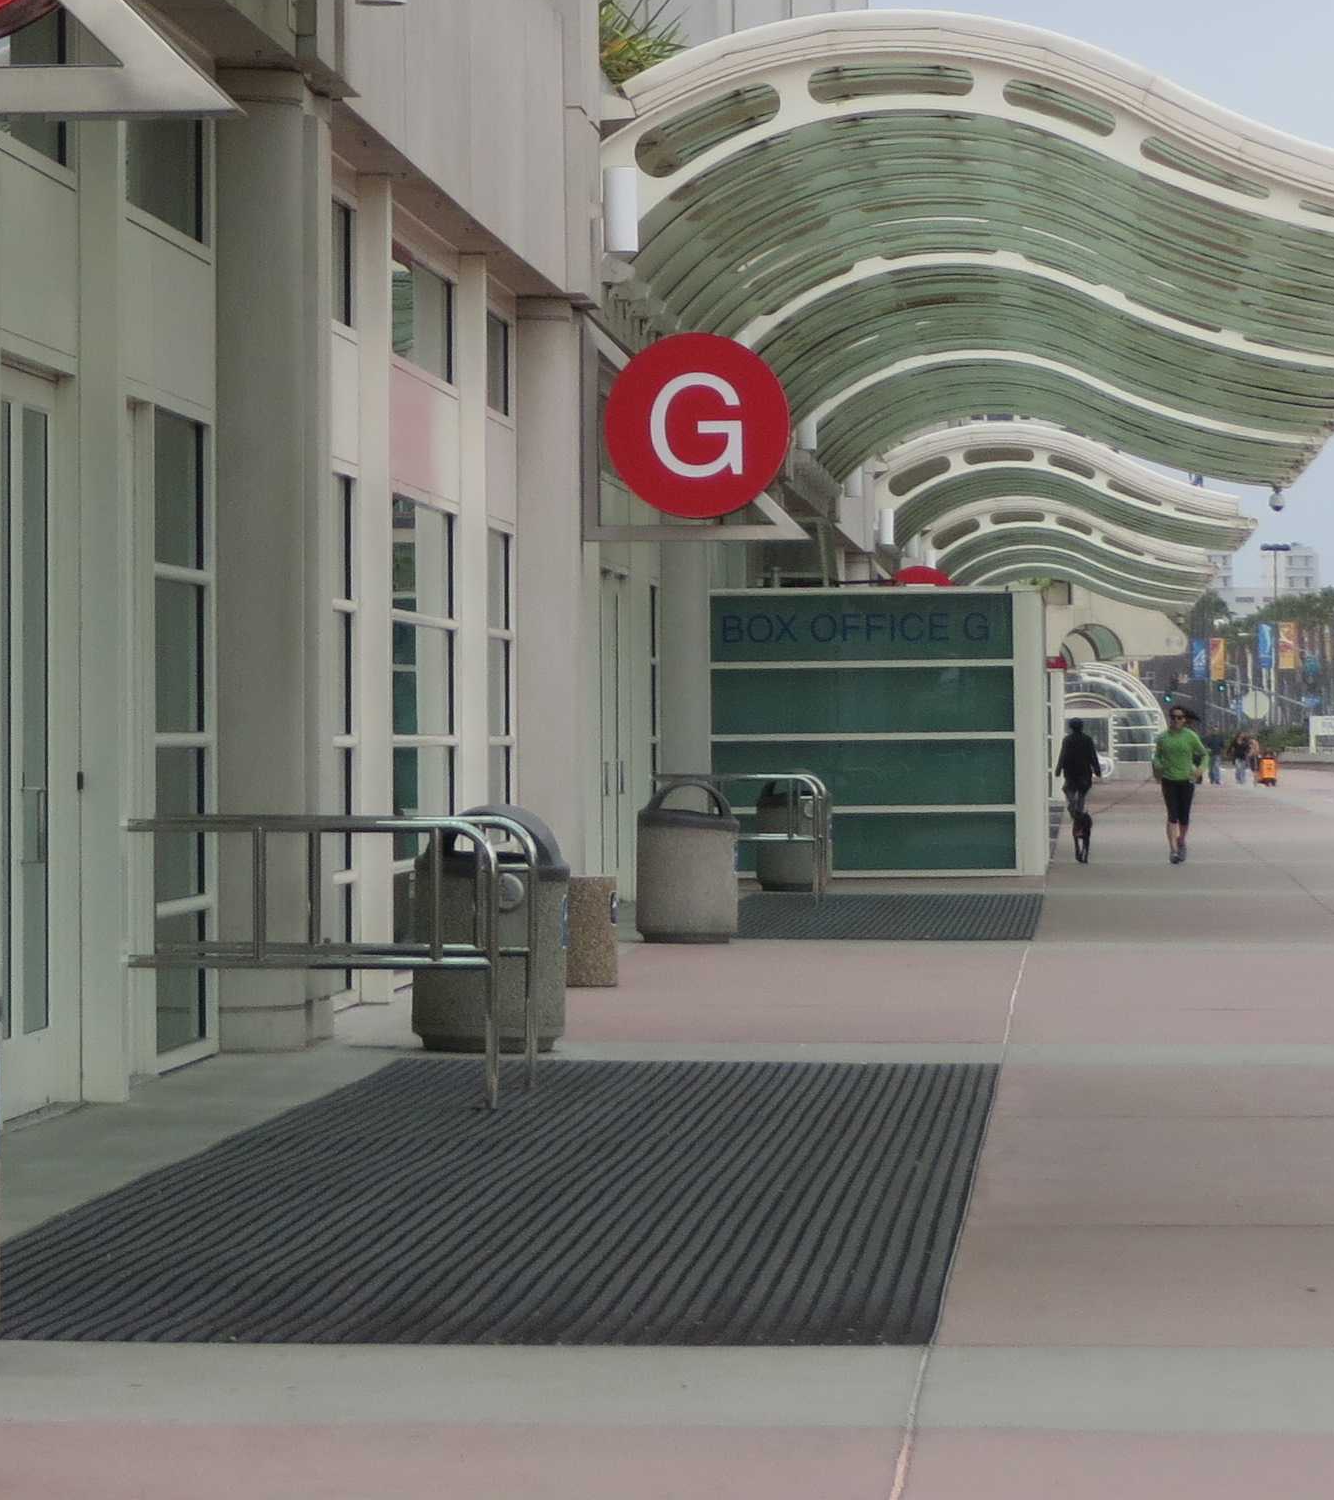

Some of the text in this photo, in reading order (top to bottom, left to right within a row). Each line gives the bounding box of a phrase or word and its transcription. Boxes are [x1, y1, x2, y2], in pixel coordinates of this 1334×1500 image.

[649, 371, 744, 478] G
[721, 611, 991, 643] BOX OFFICE G
